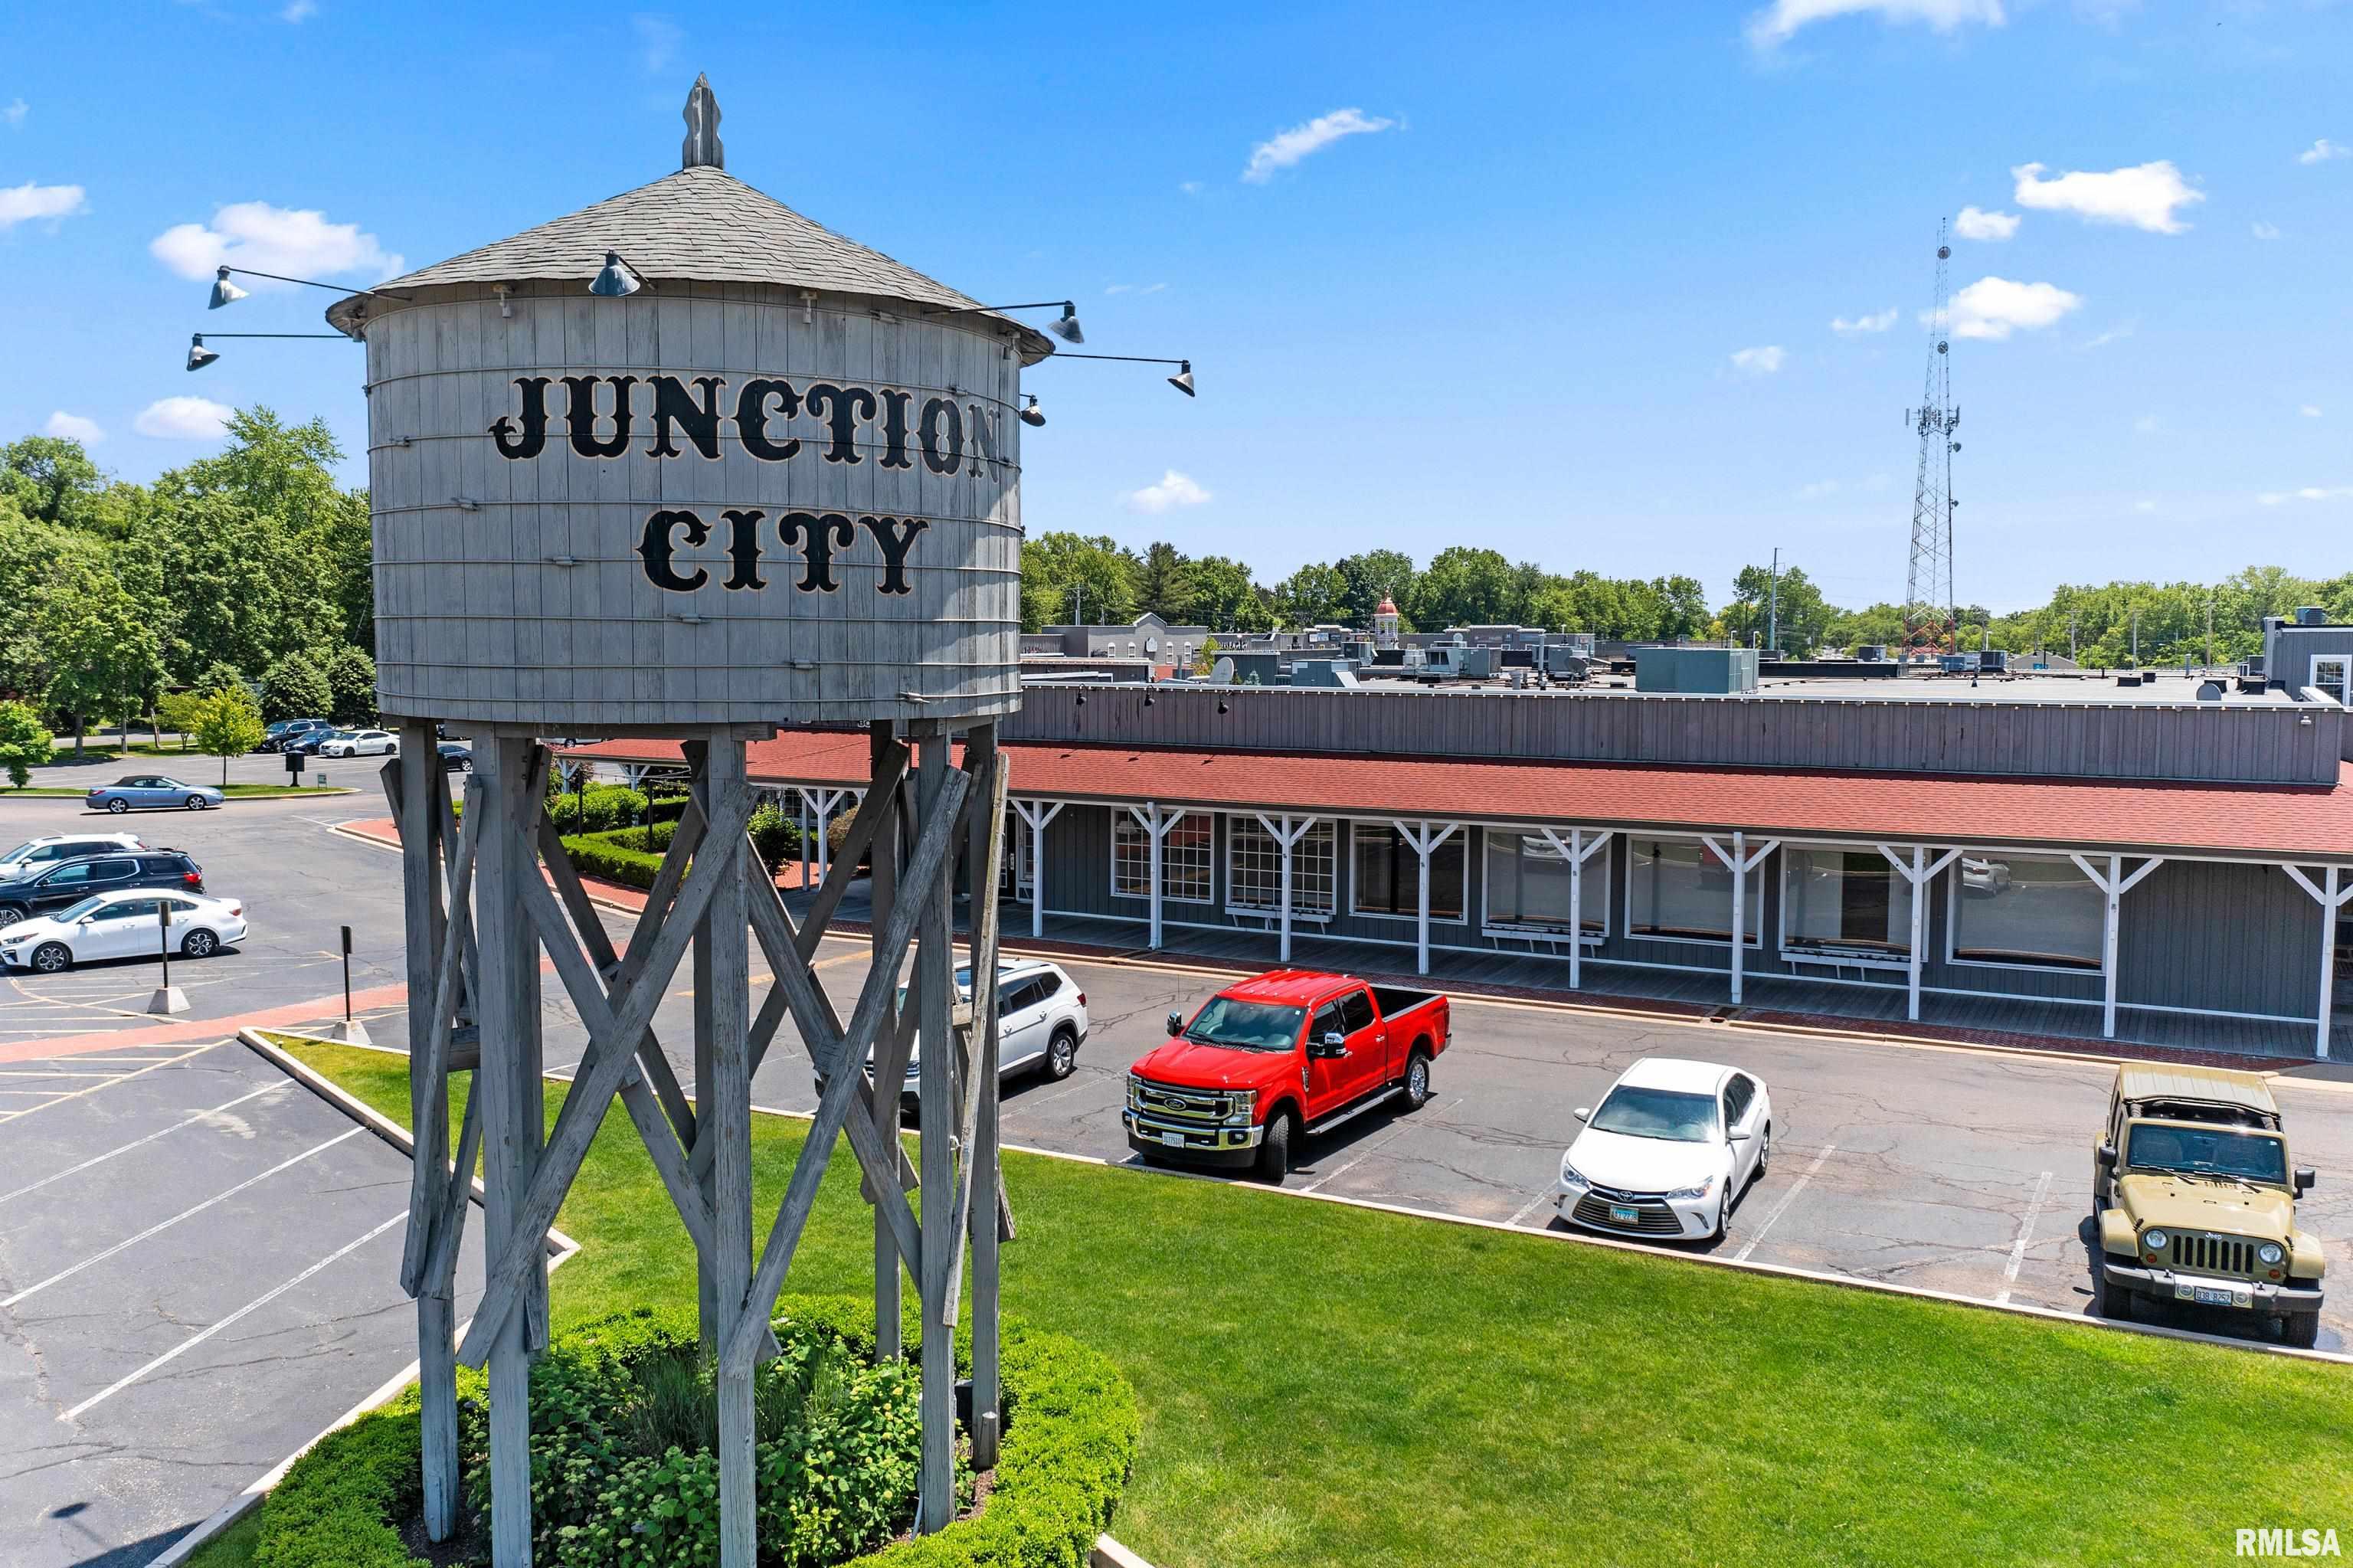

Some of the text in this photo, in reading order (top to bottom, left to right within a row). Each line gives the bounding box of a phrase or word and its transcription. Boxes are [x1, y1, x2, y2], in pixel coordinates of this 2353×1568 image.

[489, 375, 999, 483] JUNCTION
[635, 509, 930, 595] CITY
[2205, 1232, 2222, 1240] Jeep
